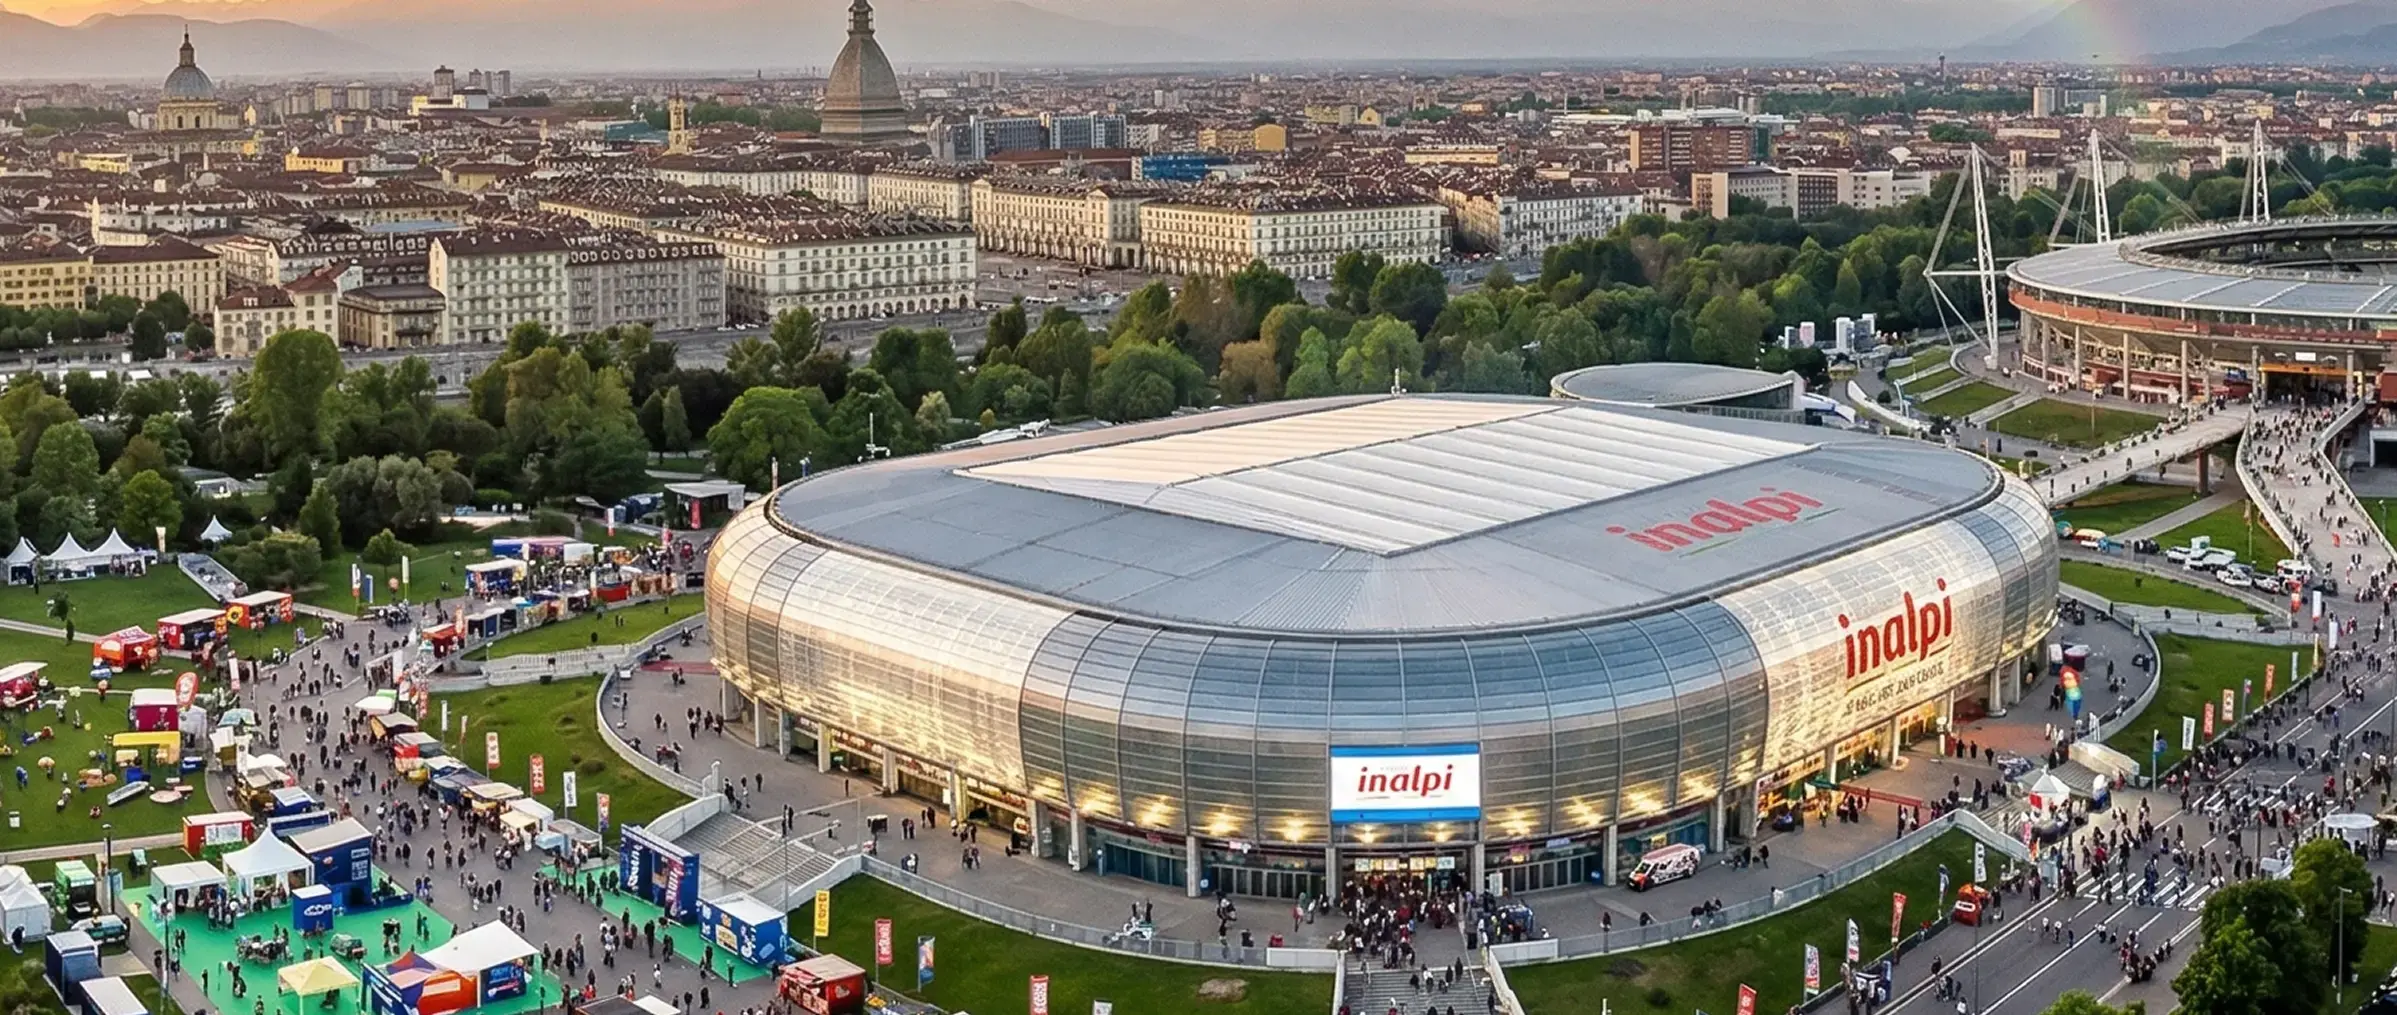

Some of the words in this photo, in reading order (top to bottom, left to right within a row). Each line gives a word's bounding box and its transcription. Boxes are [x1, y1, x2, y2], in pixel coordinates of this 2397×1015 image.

[1605, 487, 1824, 551] inalpi
[1838, 577, 1952, 680] inalpi
[1358, 764, 1453, 797] inalpi
